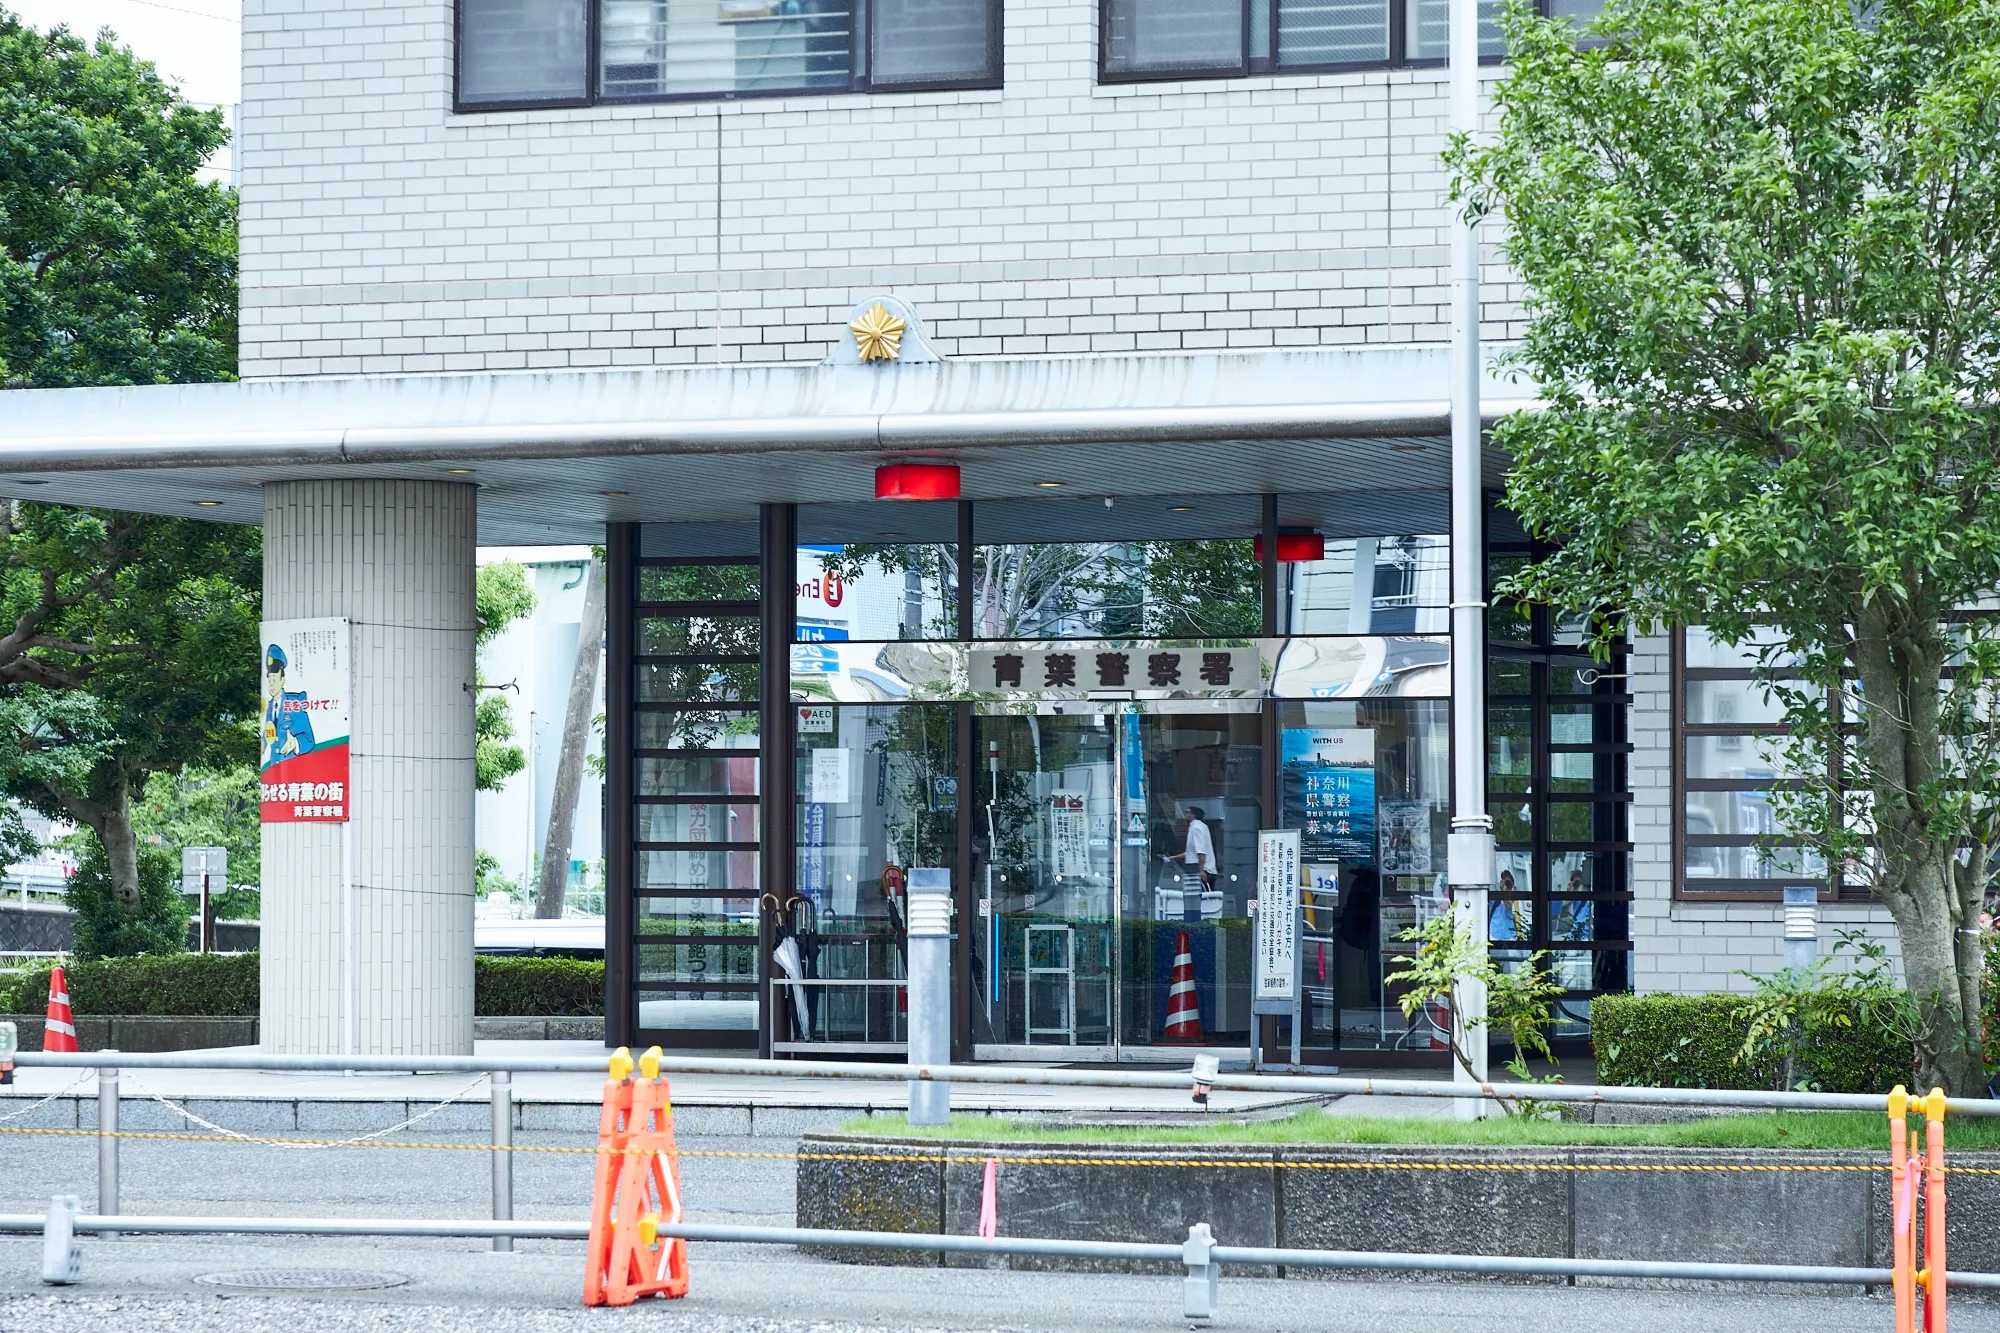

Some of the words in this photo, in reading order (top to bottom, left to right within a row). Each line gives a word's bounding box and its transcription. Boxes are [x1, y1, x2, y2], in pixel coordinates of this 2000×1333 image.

[992, 652, 1234, 688] 青葉警察署
[812, 710, 832, 718] AED
[1306, 776, 1350, 791] 神奈川
[1306, 793, 1350, 808] 県警察
[1284, 848, 1294, 960] 免許更新される方へ
